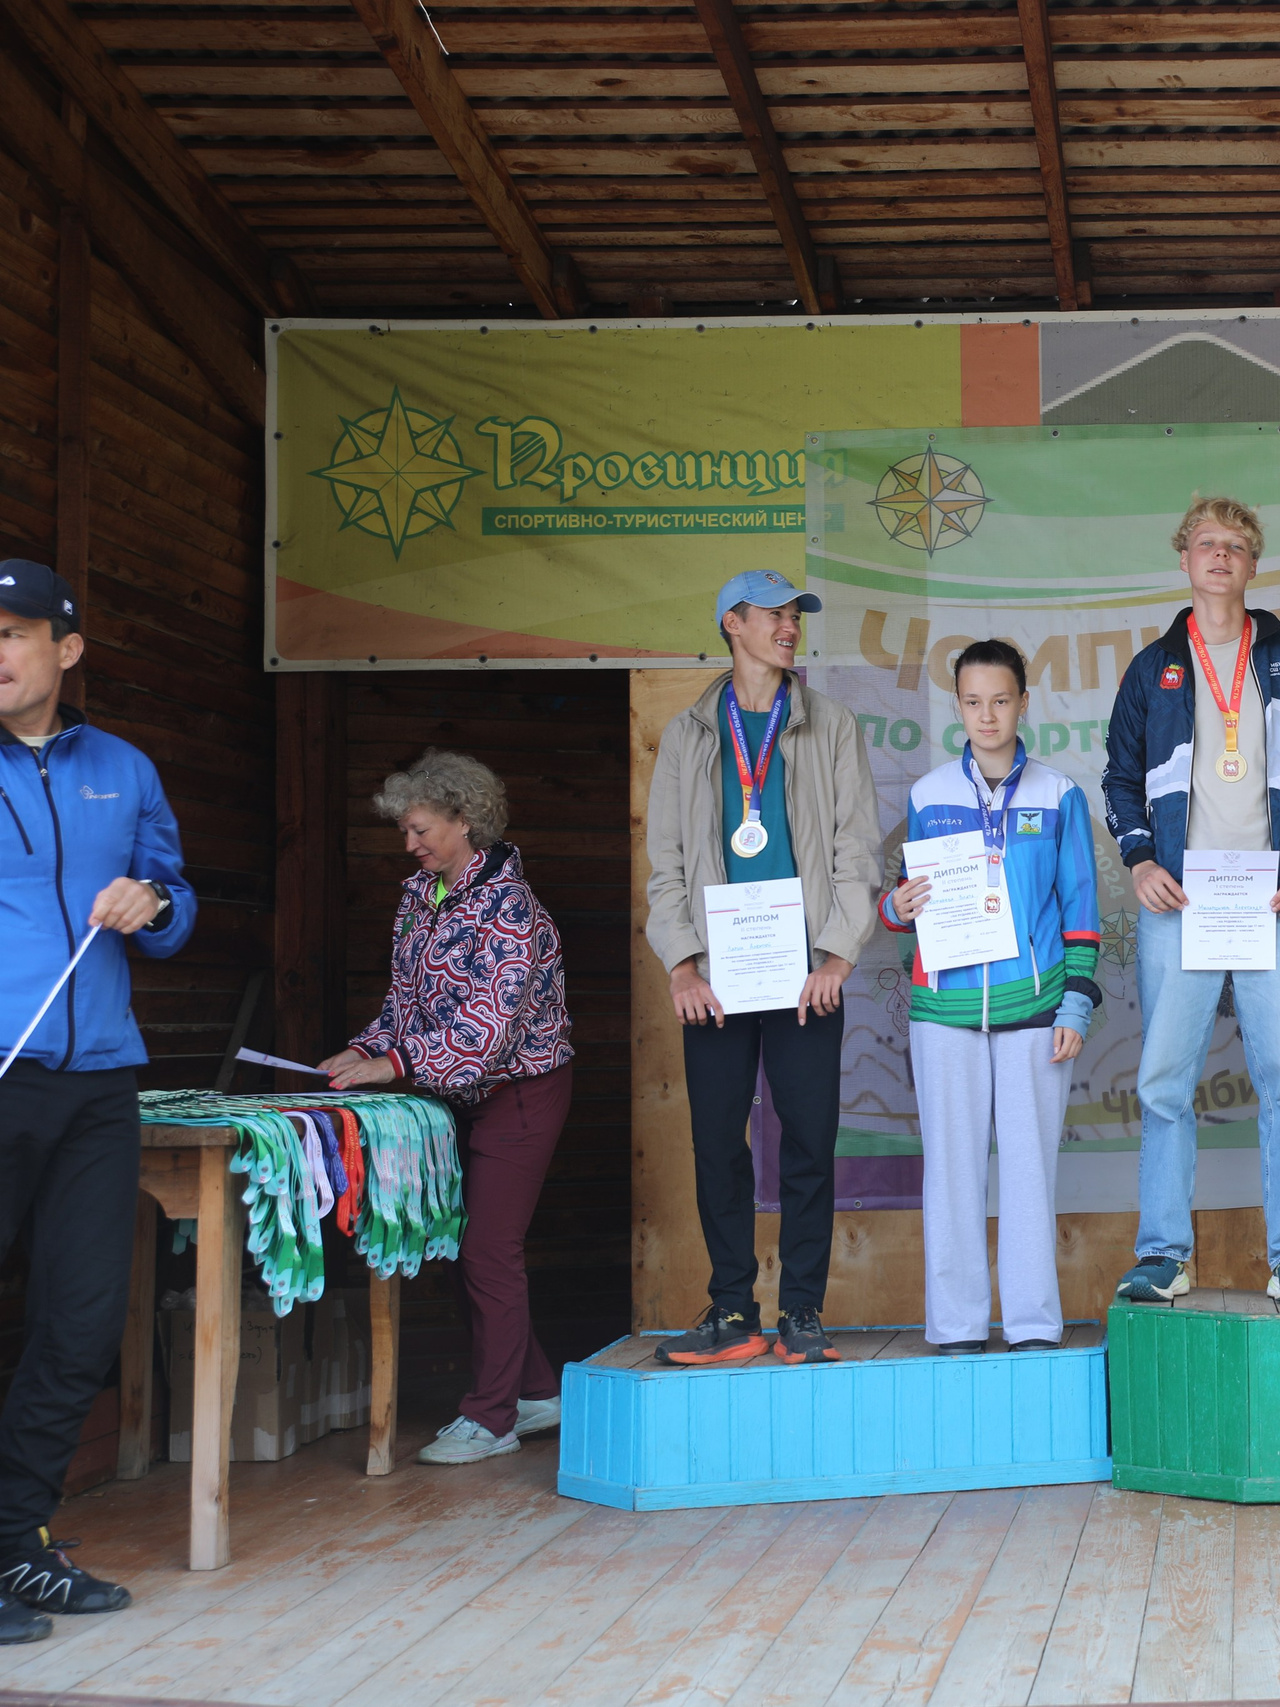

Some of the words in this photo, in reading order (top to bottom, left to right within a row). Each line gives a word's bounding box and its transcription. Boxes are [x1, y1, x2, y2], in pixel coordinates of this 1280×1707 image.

[494, 509, 767, 529] СПОРТИВНО-ТУРИСТИЧЕСКИЙ
[933, 864, 979, 879] ДИПЛОМ
[1208, 875, 1254, 883] ДИПЛОМ
[732, 913, 779, 926] ДИПЛОМ
